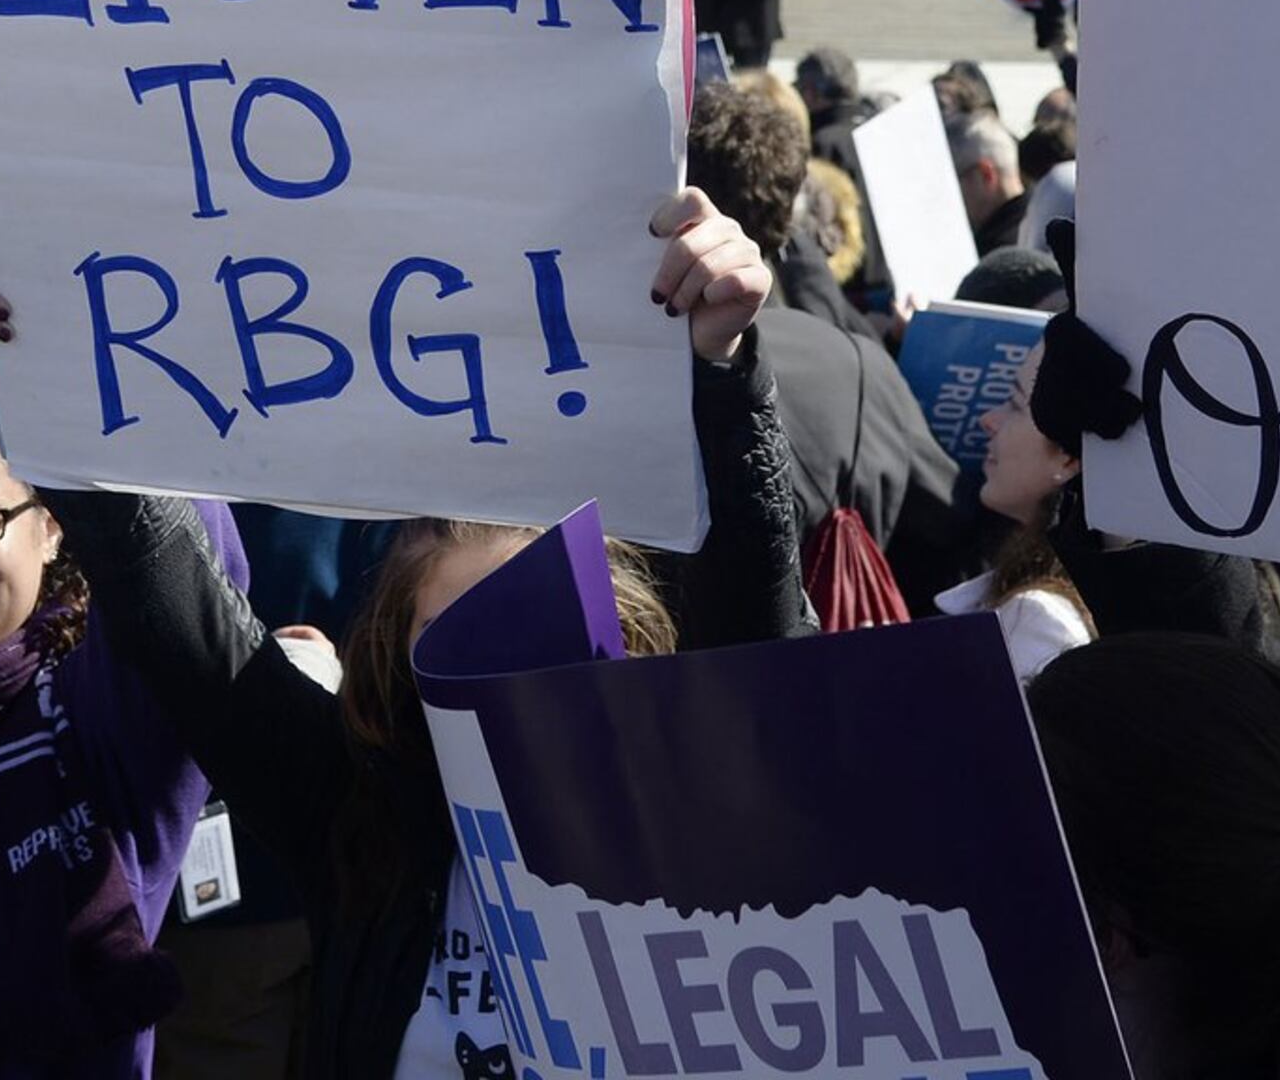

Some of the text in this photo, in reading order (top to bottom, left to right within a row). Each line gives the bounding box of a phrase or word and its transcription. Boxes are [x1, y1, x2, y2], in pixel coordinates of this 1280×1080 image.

[124, 58, 350, 220] TO
[74, 248, 589, 447] RBG!
[576, 910, 1002, 1076] LEGAL
